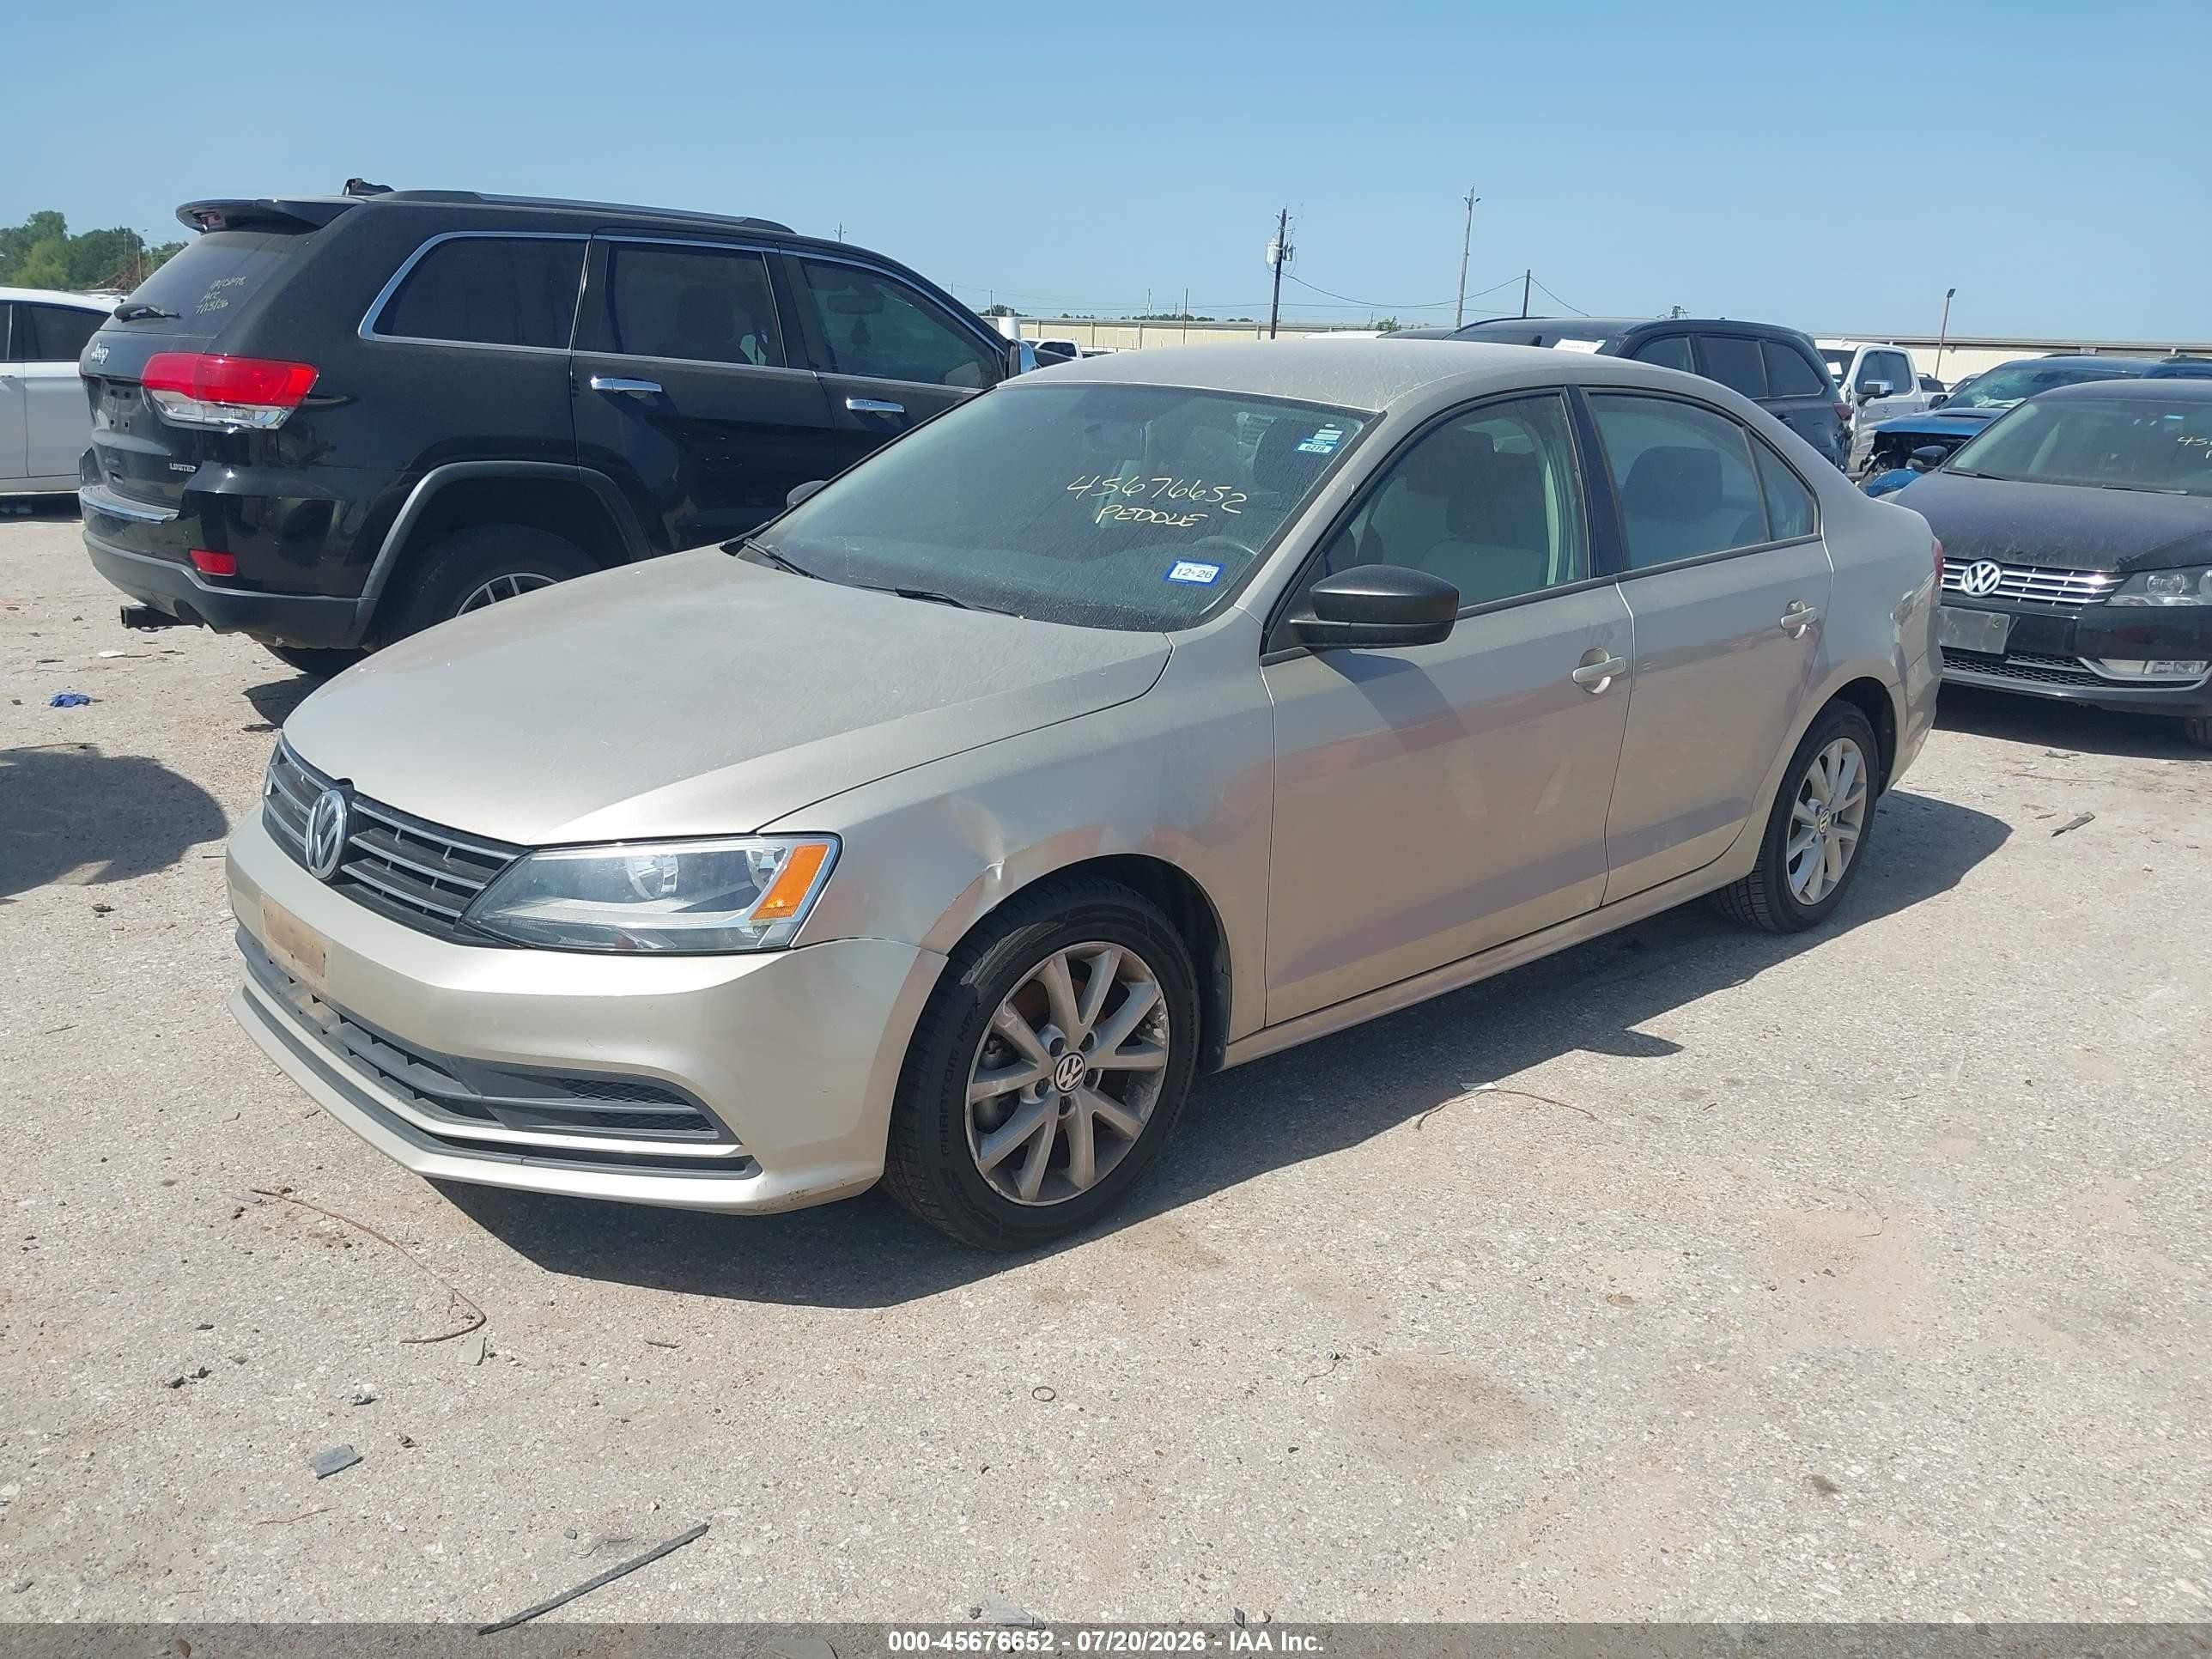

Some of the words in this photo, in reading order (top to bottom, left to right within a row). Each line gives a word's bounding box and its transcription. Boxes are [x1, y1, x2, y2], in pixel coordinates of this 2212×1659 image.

[91, 343, 110, 365] Jeep
[2177, 435, 2212, 447] 45
[1066, 474, 1248, 514] 45676652
[1094, 503, 1209, 527] PEDDLE
